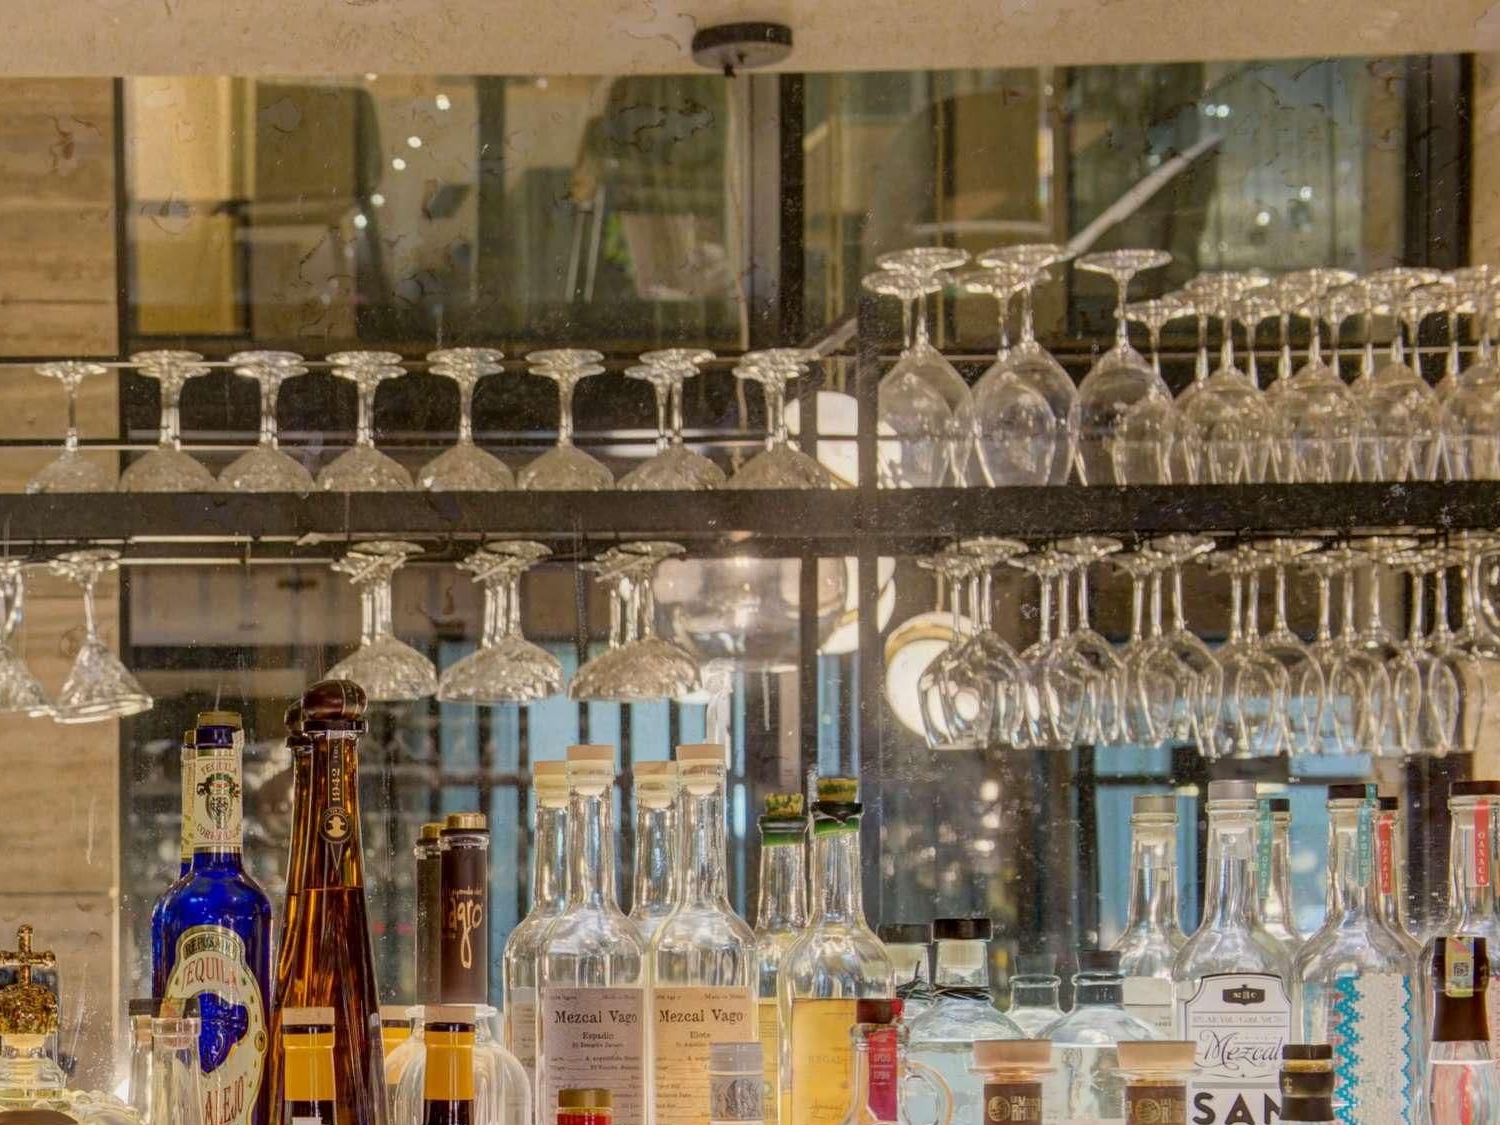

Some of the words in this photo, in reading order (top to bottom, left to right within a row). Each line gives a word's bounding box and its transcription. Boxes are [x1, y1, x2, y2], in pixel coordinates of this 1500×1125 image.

[554, 1010, 602, 1023] Mezcal
[609, 1010, 638, 1025] Vago
[659, 1010, 705, 1023] Mezcal
[712, 1009, 744, 1024] Vago
[1198, 1030, 1283, 1071] Mezcal
